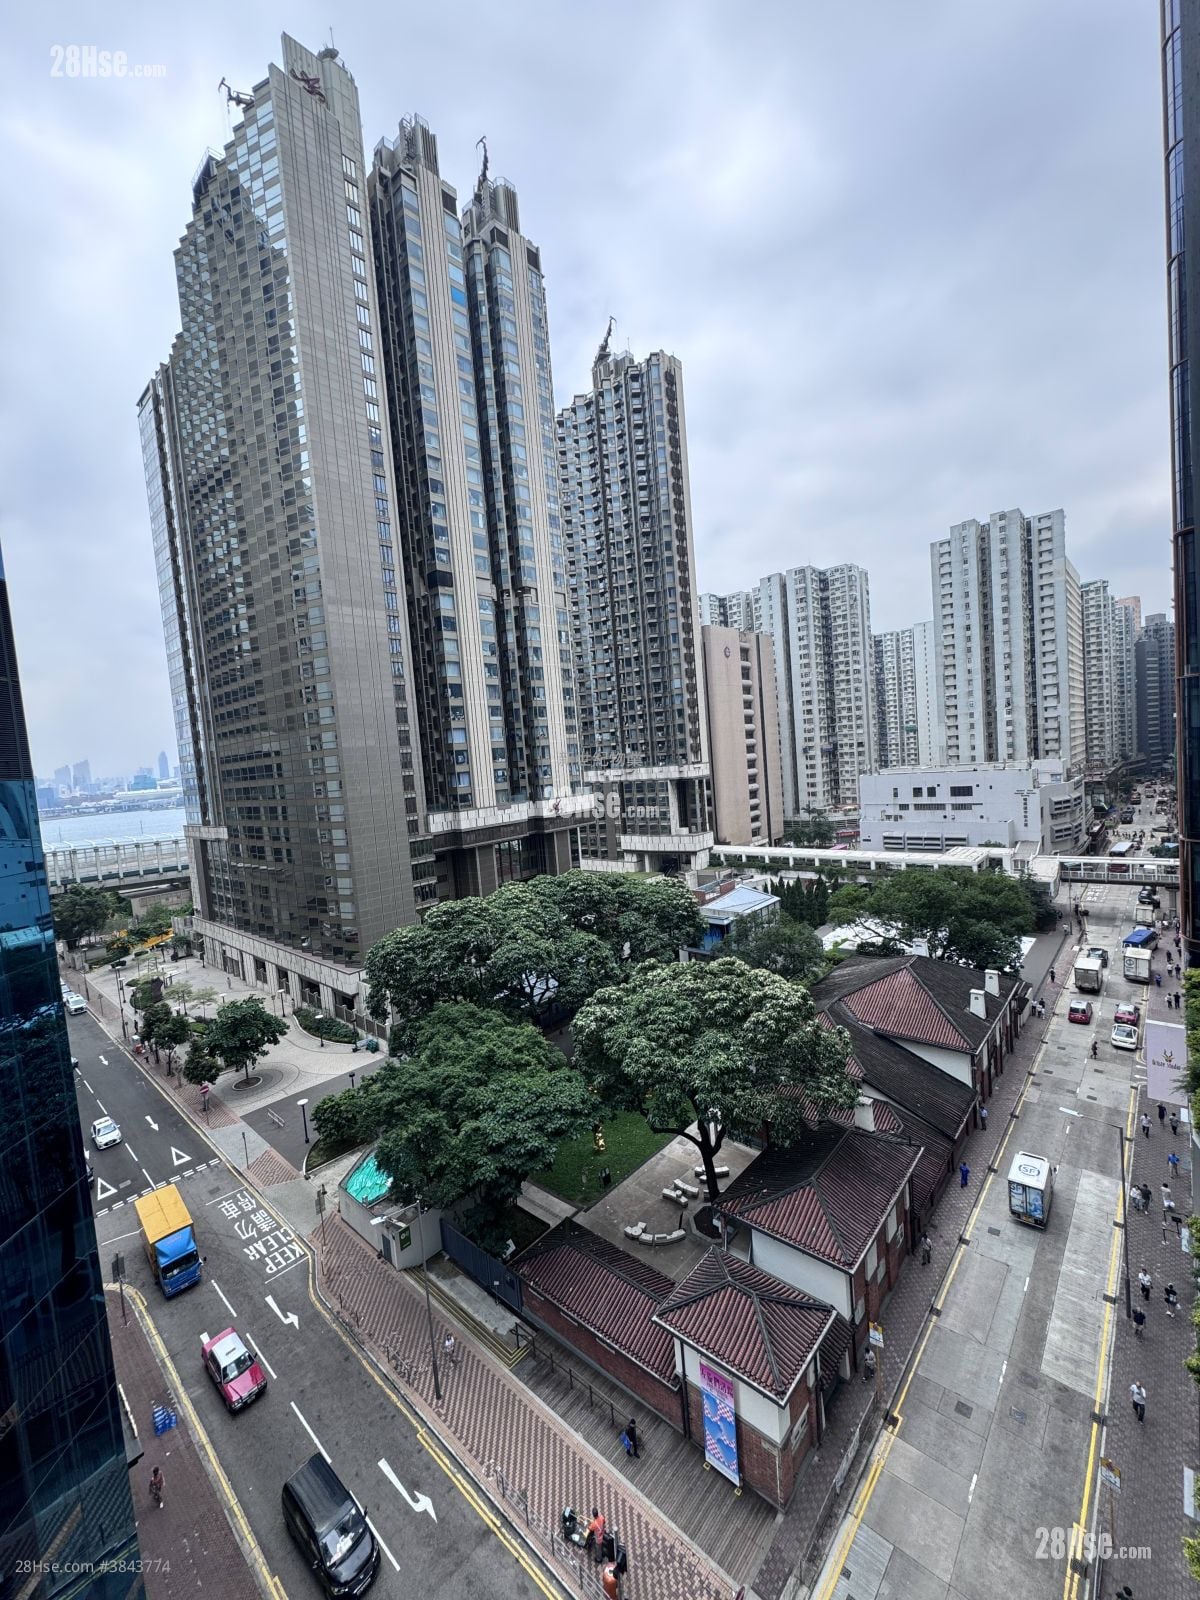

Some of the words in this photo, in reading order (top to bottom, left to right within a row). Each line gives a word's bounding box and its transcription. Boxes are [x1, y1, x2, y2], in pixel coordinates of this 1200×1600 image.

[218, 1191, 256, 1219] 停車
[243, 1226, 295, 1260] CLEAR
[265, 1241, 304, 1273] KEEP
